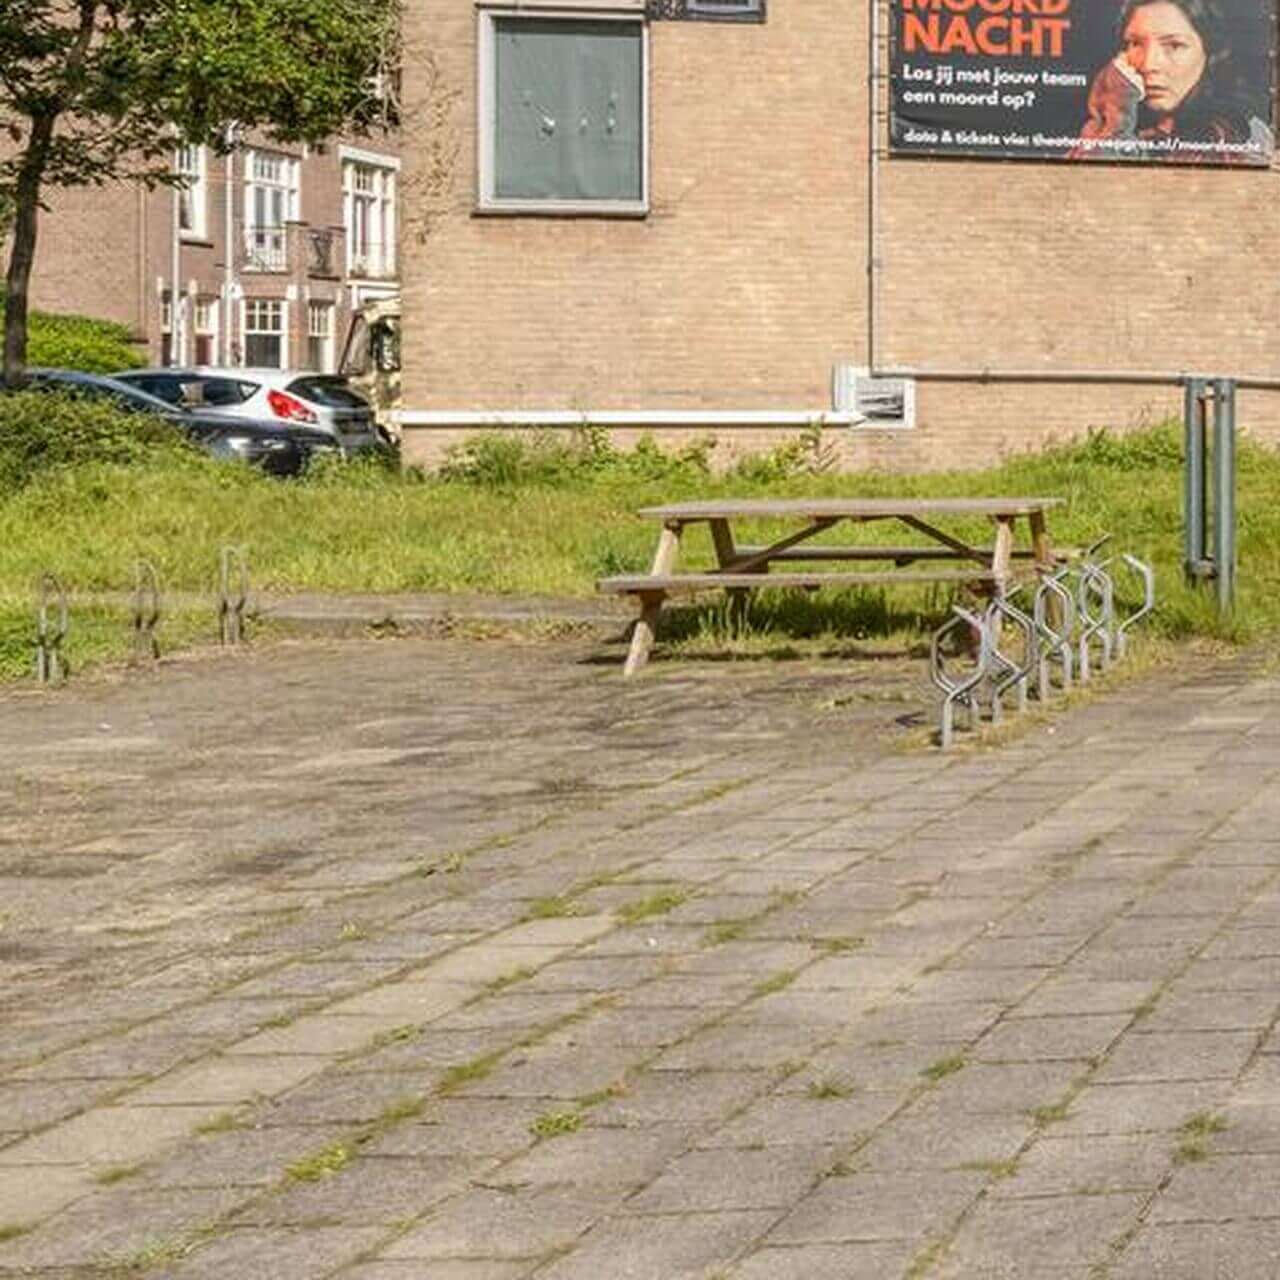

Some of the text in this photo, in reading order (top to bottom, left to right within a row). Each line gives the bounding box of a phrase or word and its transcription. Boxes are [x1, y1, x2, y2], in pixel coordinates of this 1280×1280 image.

[903, 13, 1071, 57] NACHT
[903, 64, 1087, 86] Los jij met jouw team
[903, 90, 1036, 110] een moord op?
[955, 130, 1000, 145] tickets
